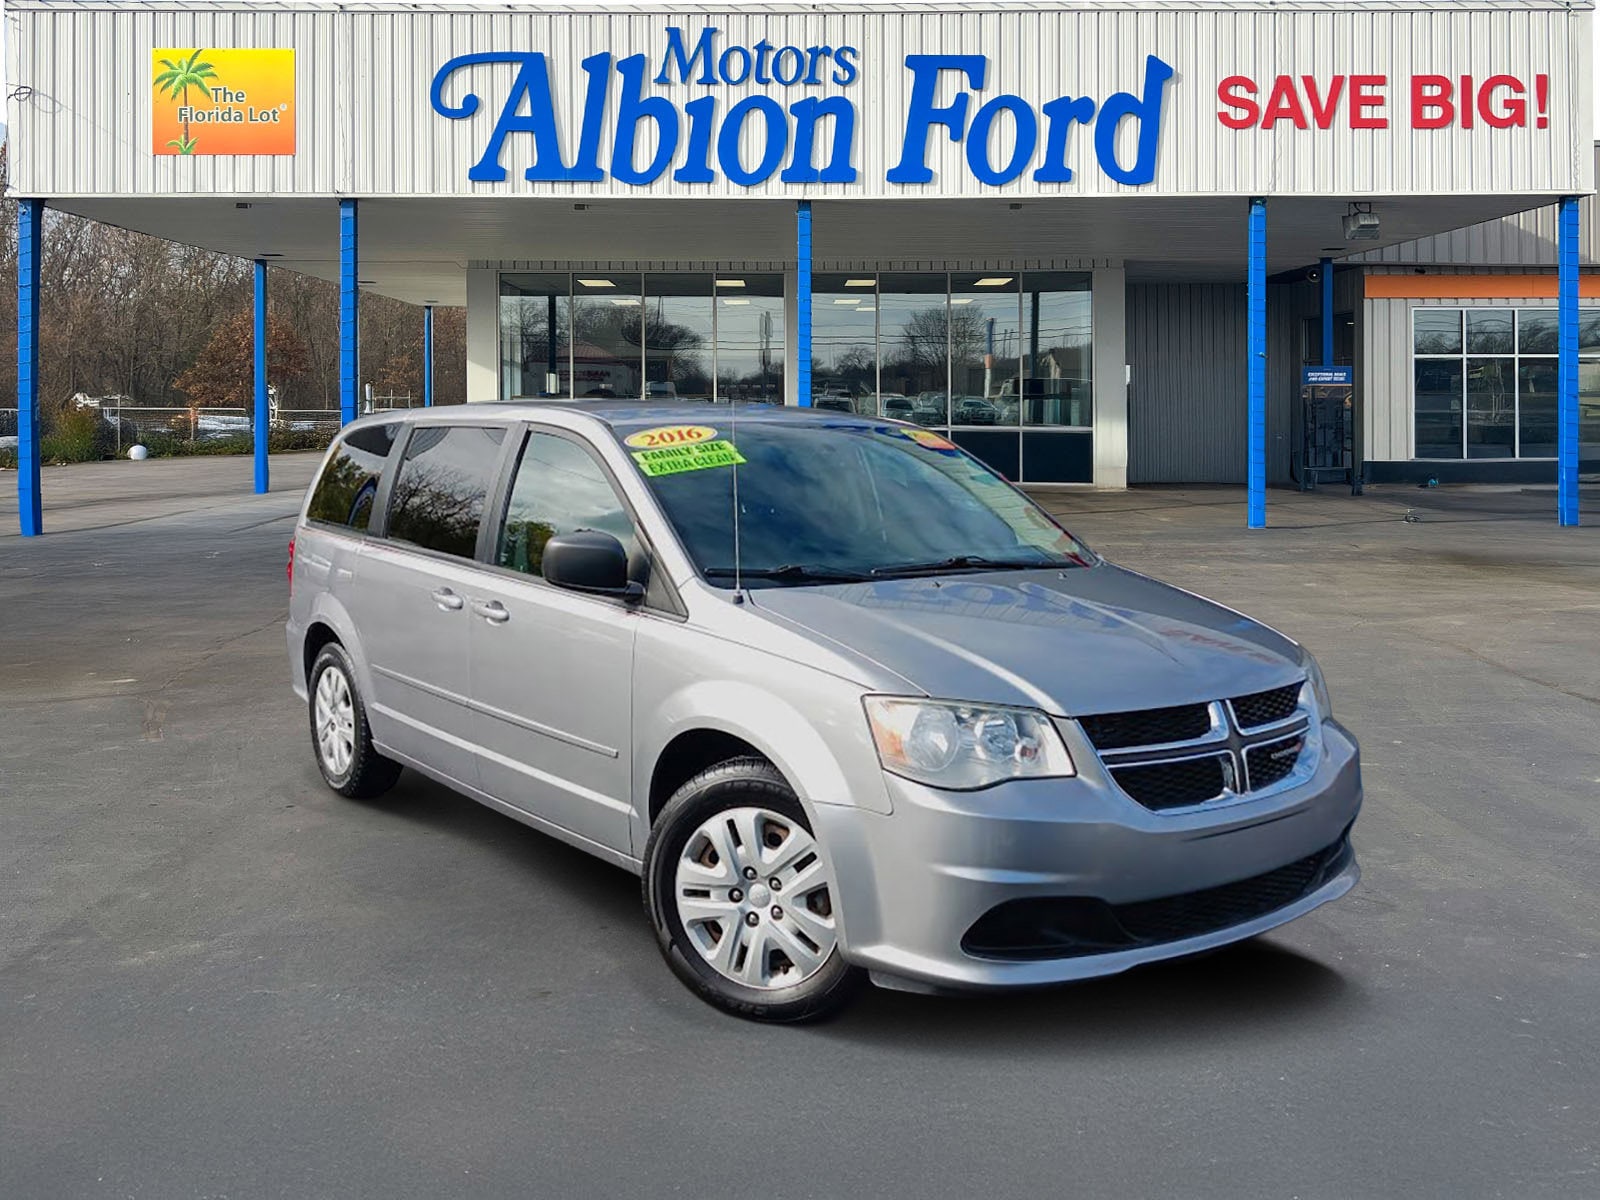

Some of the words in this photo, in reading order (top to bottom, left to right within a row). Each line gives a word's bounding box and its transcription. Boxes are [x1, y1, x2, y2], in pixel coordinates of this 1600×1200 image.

[655, 27, 857, 85] Motors
[210, 86, 246, 103] The
[1217, 74, 1388, 129] SAVE
[1411, 74, 1549, 129] BIG!
[178, 106, 244, 123] Florida
[248, 106, 280, 123] Lot
[430, 52, 858, 186] Albion
[886, 55, 1175, 186] Ford
[641, 428, 703, 446] 2016
[641, 446, 693, 461] FAMILY
[694, 441, 726, 454] SIZE
[647, 459, 694, 474] EXTRA
[693, 451, 736, 467] CLEAN
